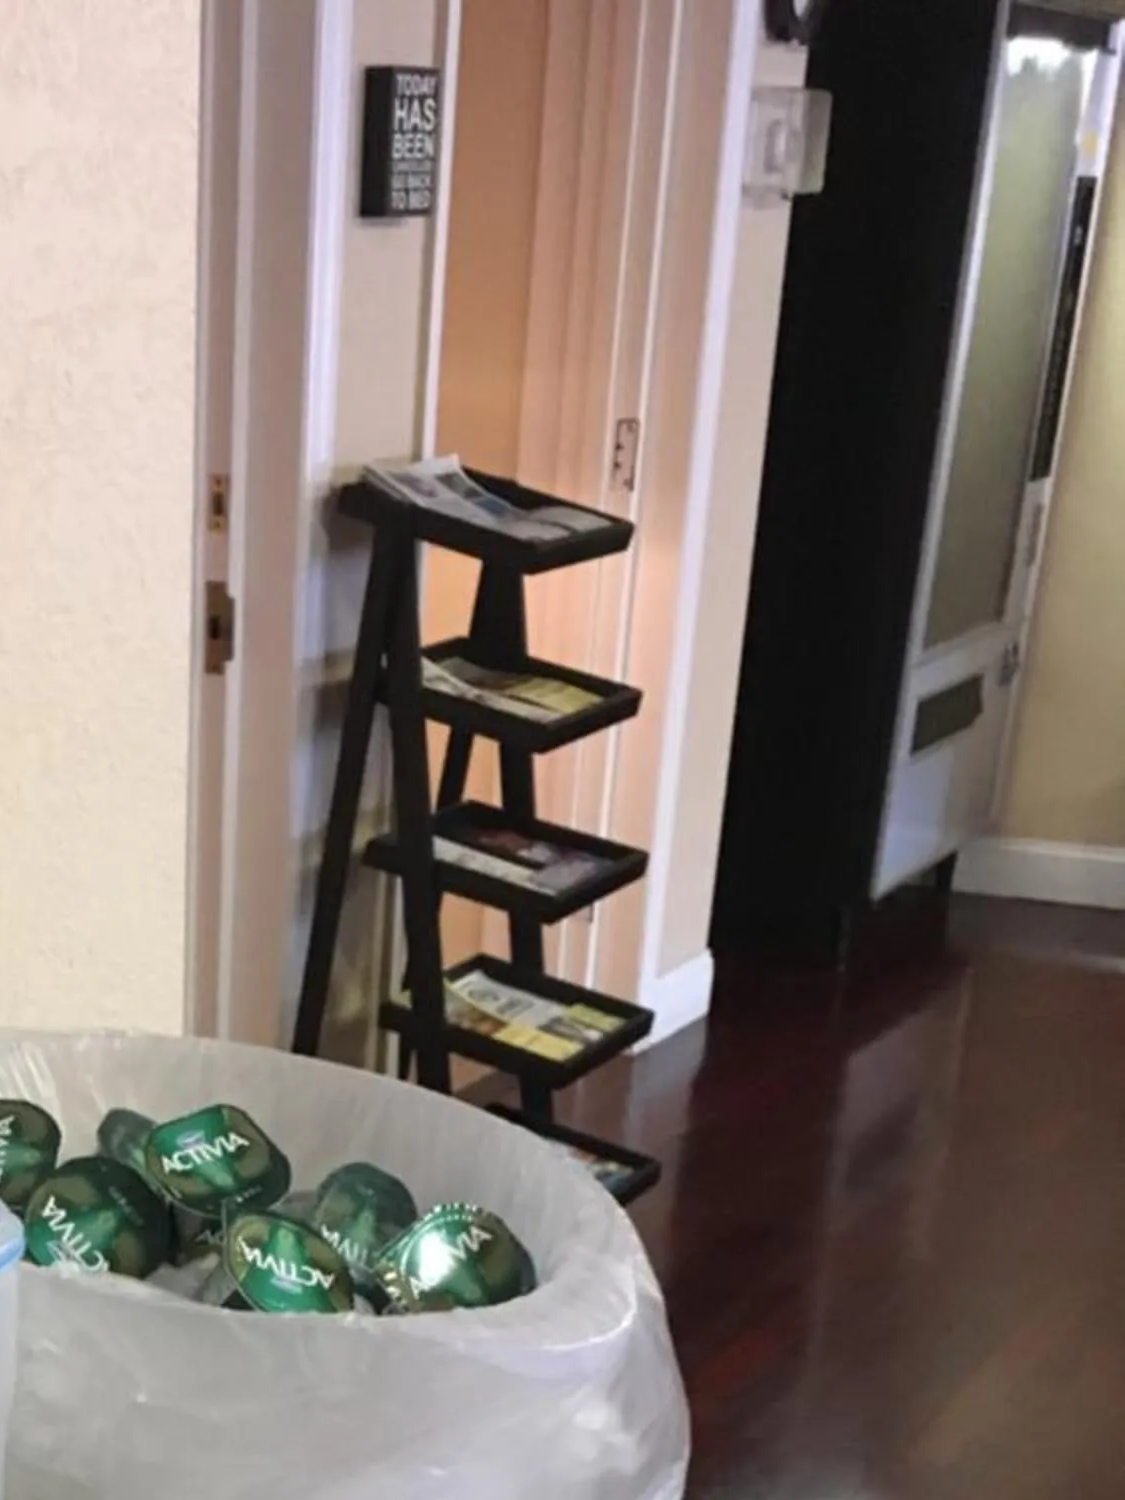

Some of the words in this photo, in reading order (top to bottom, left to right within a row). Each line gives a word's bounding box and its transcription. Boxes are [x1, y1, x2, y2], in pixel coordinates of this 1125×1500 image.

[394, 97, 436, 131] HAS
[392, 132, 434, 159] BEEN
[161, 1132, 251, 1176] ACTIVIA
[42, 1196, 110, 1274] CTIVIA
[238, 1227, 335, 1290] ACTIVIA
